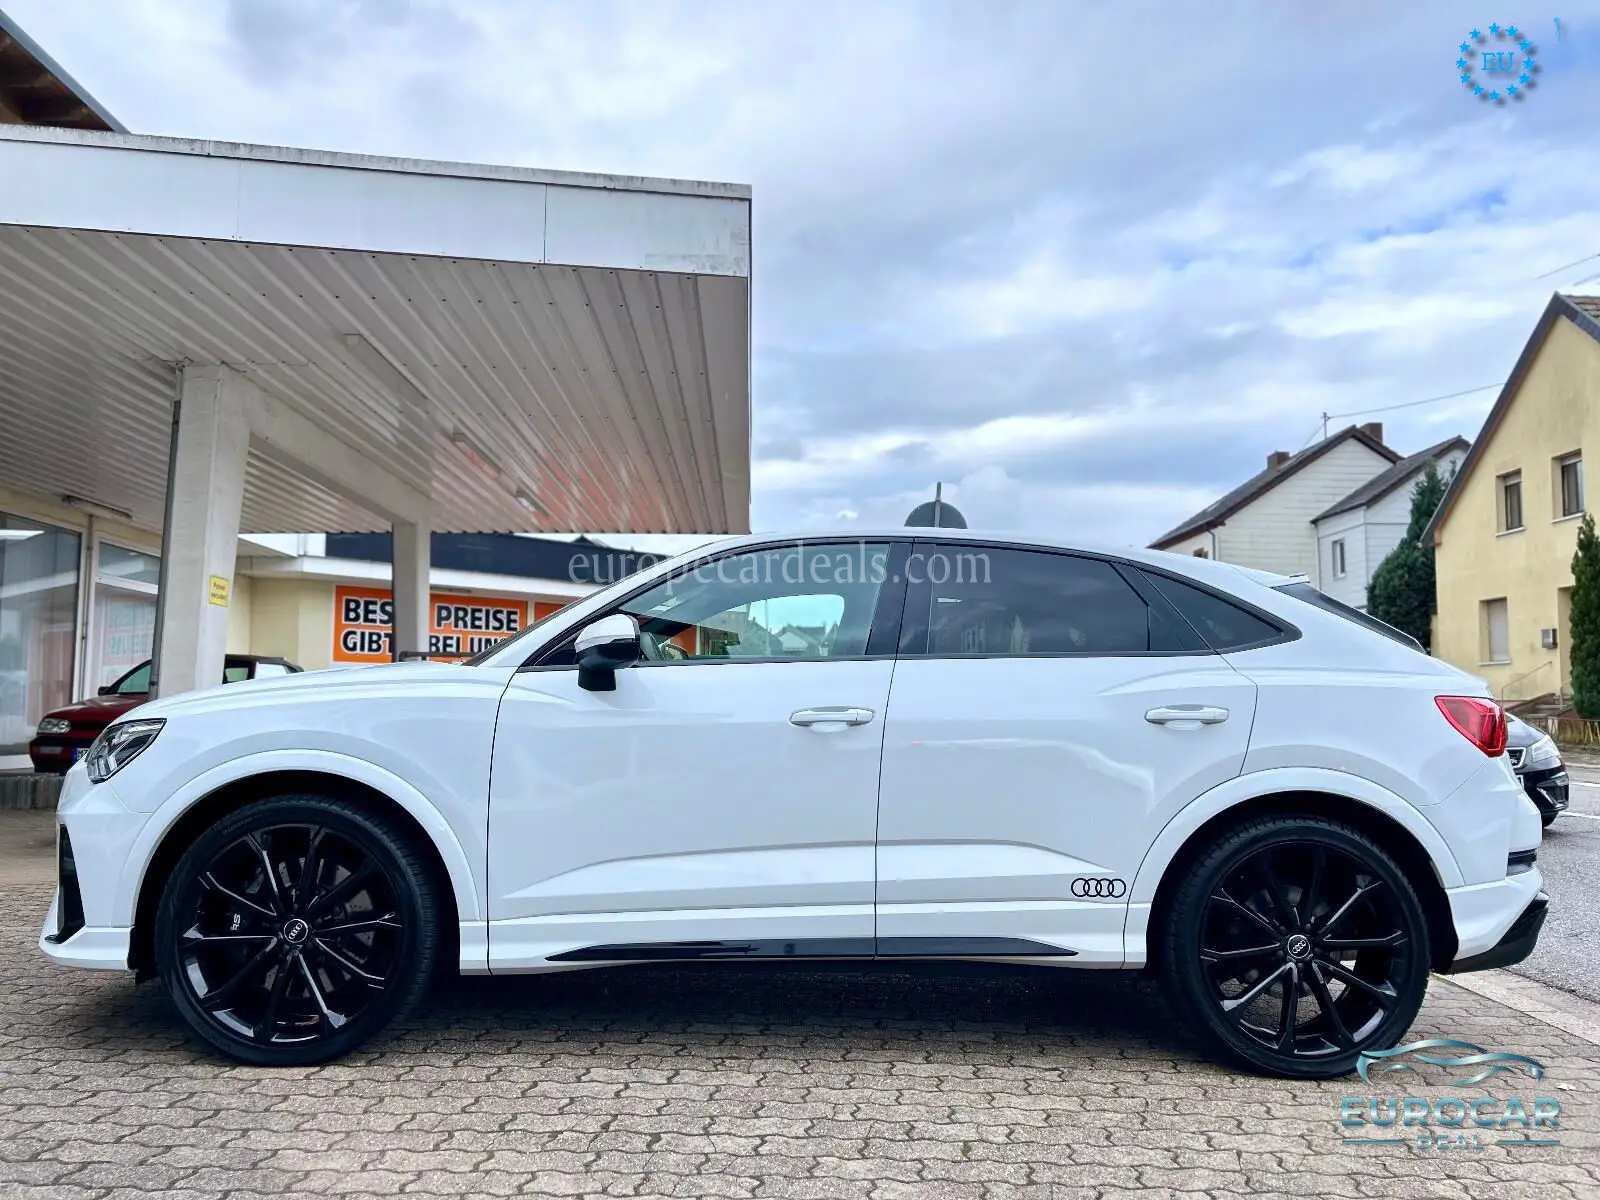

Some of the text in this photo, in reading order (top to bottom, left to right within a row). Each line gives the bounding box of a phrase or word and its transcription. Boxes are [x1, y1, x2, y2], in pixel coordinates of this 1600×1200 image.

[343, 597, 519, 632] BES PREISE
[429, 634, 461, 653] BEI
